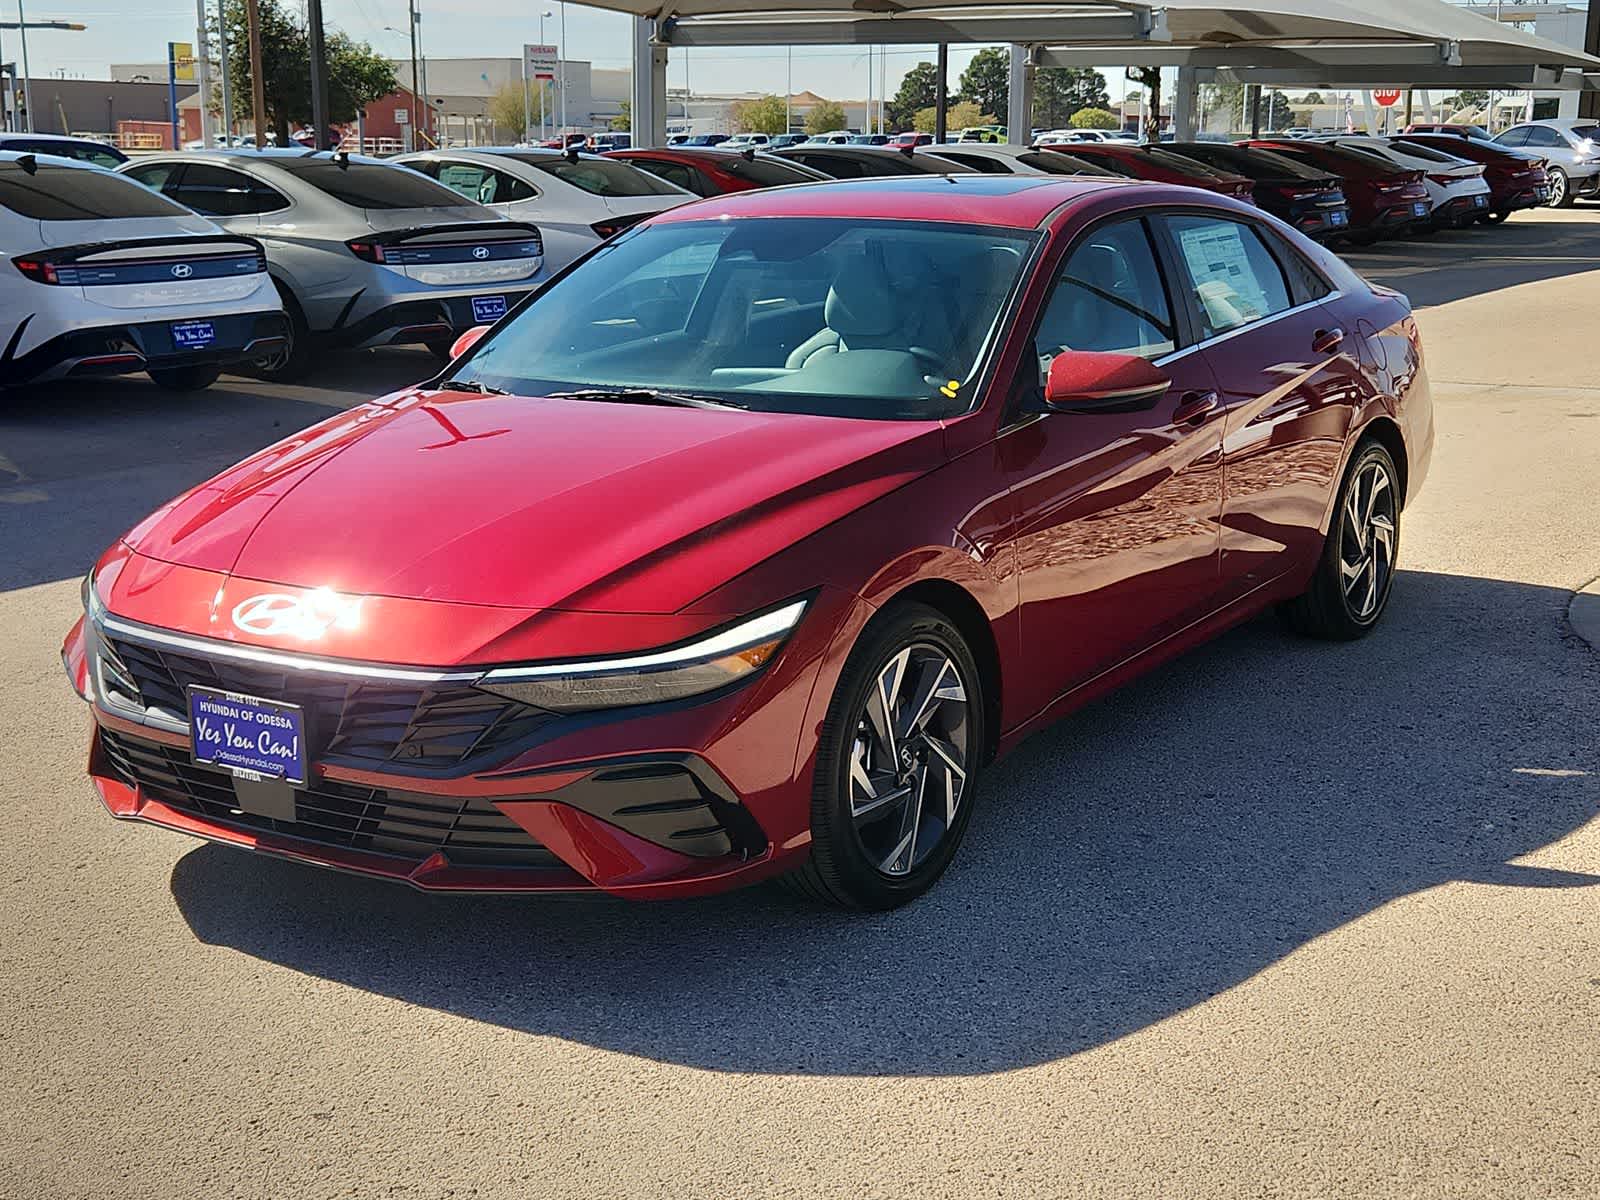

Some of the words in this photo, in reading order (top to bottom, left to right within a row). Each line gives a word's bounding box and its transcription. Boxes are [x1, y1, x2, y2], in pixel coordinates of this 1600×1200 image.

[200, 701, 239, 718] HYUNDAI
[241, 710, 254, 721] OF
[256, 713, 293, 730] ODESSA
[196, 717, 221, 744] Yes
[224, 722, 254, 749] You
[258, 731, 298, 760] Can!
[215, 749, 285, 773] OdessaHyundai.com
